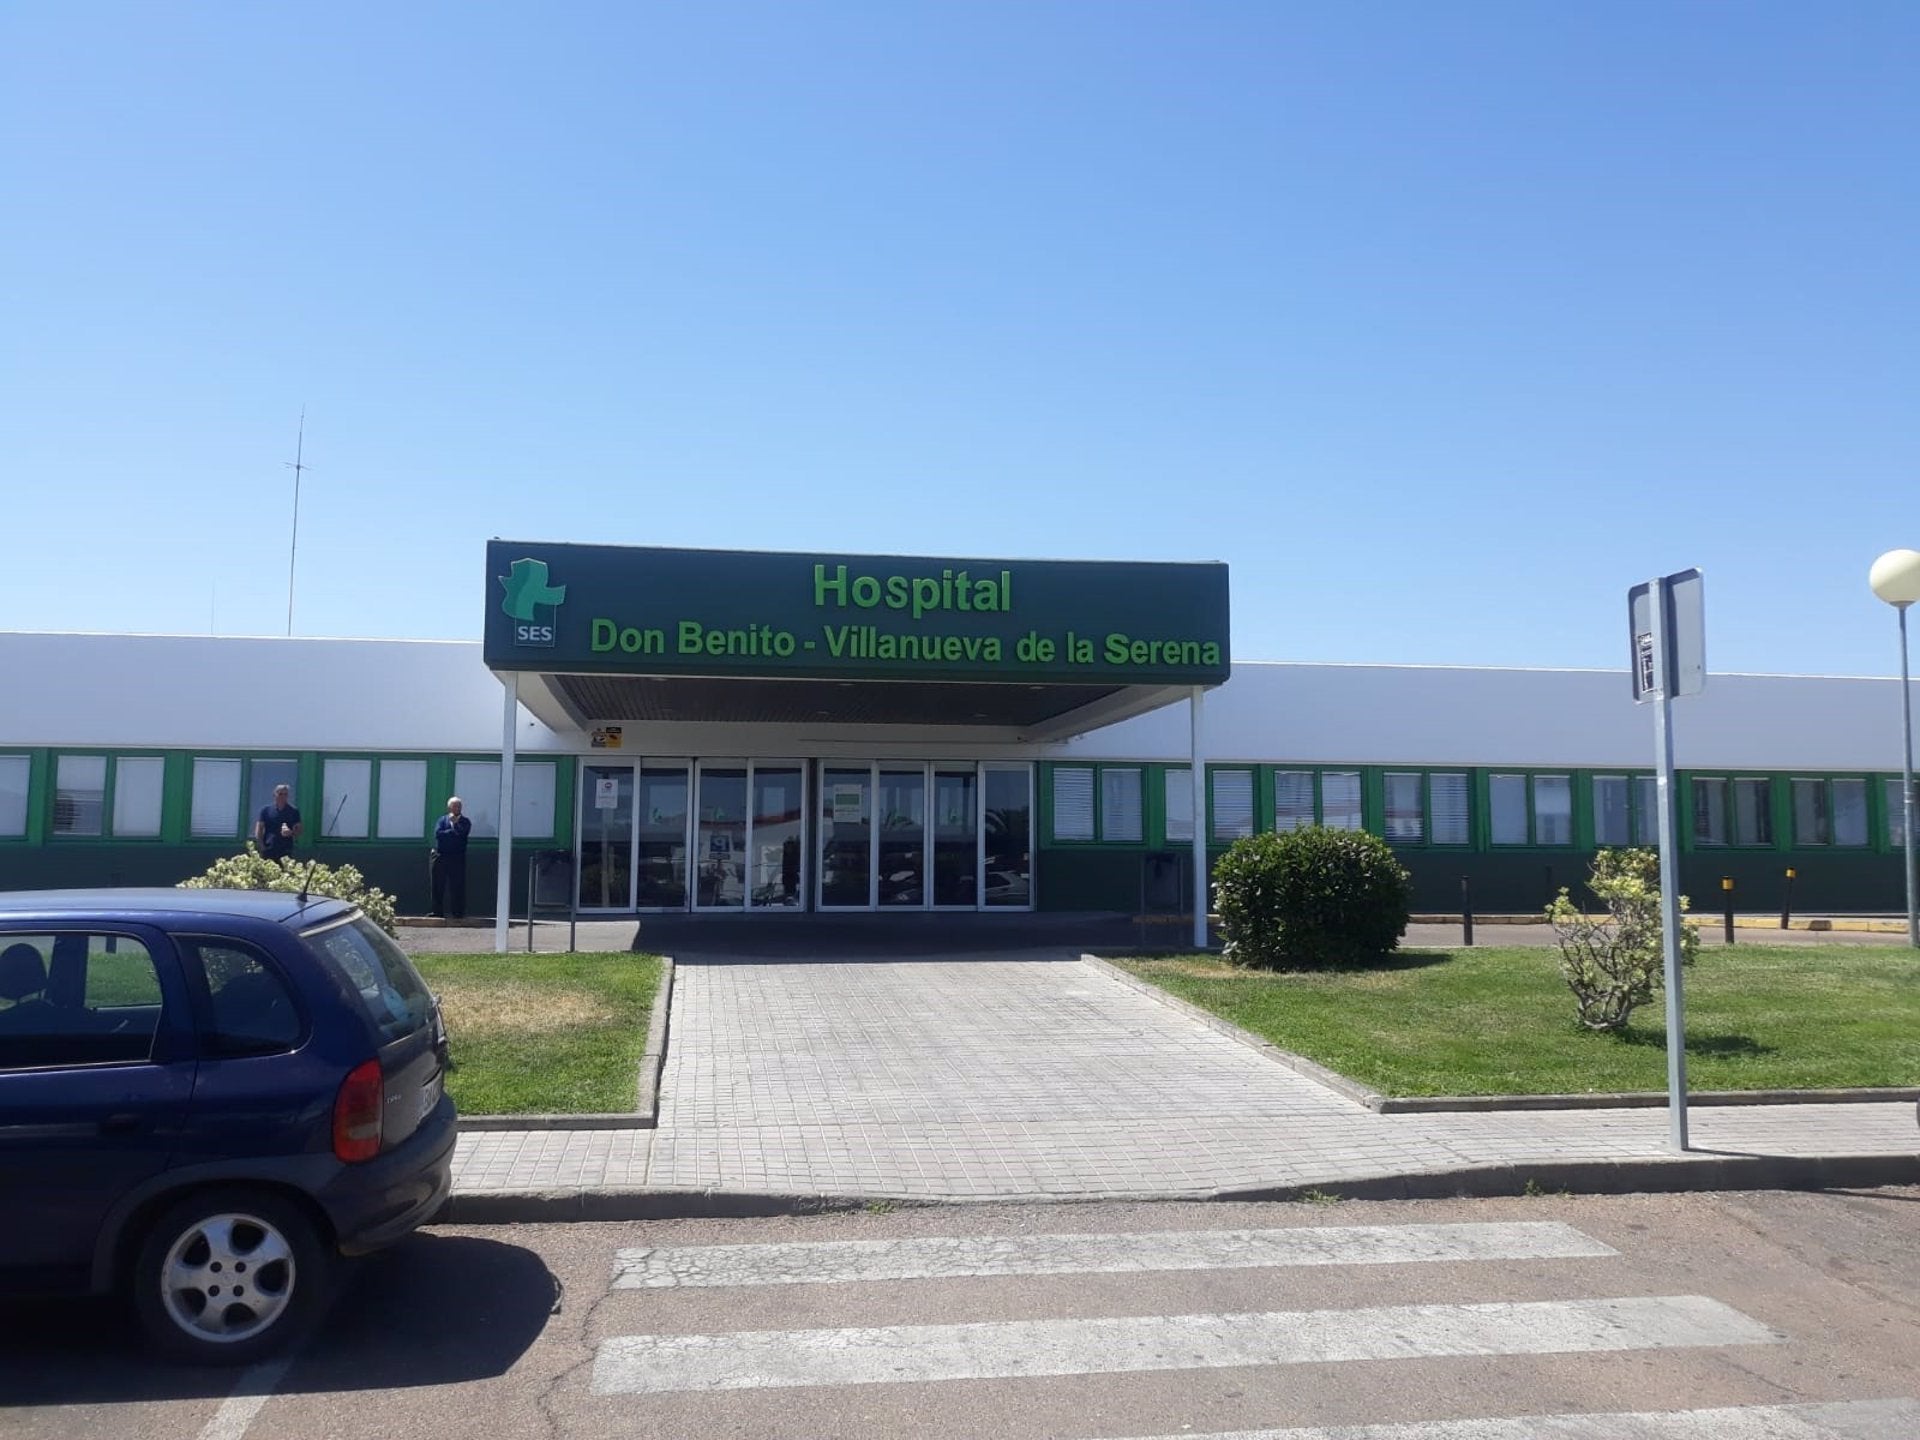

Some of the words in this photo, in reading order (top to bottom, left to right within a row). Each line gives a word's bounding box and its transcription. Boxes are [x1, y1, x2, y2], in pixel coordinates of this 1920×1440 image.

[813, 563, 1011, 619] Hospital
[516, 624, 554, 643] SES
[591, 618, 665, 655] Don
[678, 620, 797, 658] Benito
[803, 640, 816, 651] -
[823, 624, 1003, 662] Villanueva
[1016, 631, 1056, 664] de
[1067, 632, 1094, 665] la
[1103, 633, 1221, 666] Serena
